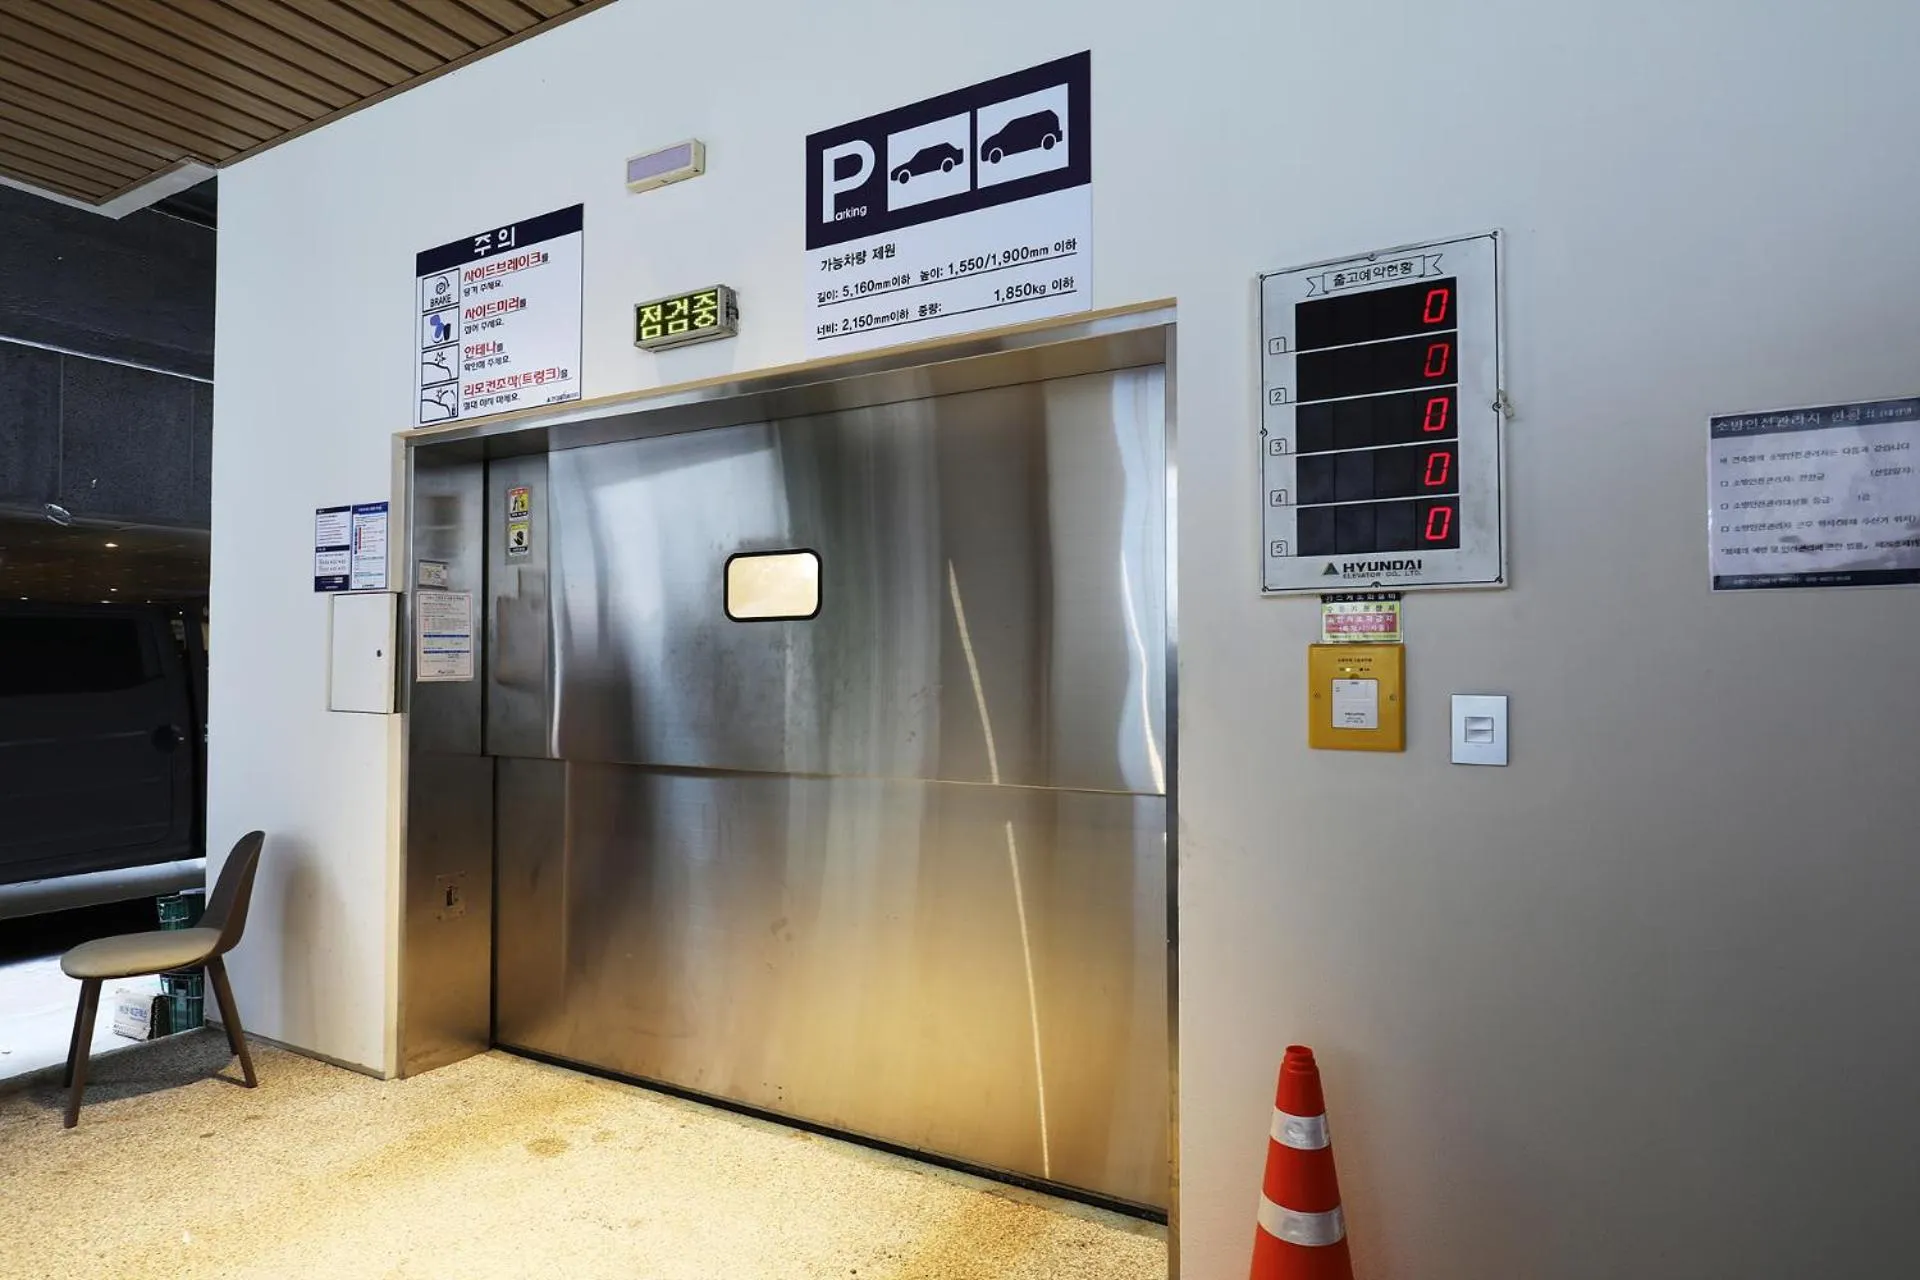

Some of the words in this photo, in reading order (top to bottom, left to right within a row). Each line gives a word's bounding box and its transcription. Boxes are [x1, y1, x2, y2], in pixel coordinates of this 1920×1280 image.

[464, 251, 549, 282] 사이드브레이크를
[816, 288, 838, 303] 길이:
[842, 274, 911, 299] 5,160mm이하
[919, 266, 943, 283] 높이:
[1053, 238, 1078, 253] 이하
[820, 250, 867, 273] 가능차량
[871, 242, 897, 261] 제원
[1333, 262, 1413, 287] 출고예약현황
[430, 294, 452, 308] BRAKE
[464, 296, 527, 319] 사이드미러를
[816, 321, 838, 336] 너비:
[842, 308, 910, 332] 2,150mm이하
[917, 303, 943, 317] 중량:
[993, 281, 1047, 303] 1,850kg
[1051, 277, 1075, 290] 이하
[1423, 289, 1449, 323] 0
[640, 292, 717, 340] 점검중
[464, 342, 504, 359] 안테나를
[1424, 344, 1449, 377] 0
[1273, 391, 1283, 402] 2
[1424, 398, 1449, 431] 0
[1274, 441, 1283, 452] 3
[1424, 452, 1450, 486] 0
[1275, 494, 1283, 504] 4
[1425, 507, 1452, 540] 0
[1275, 544, 1284, 554] 5
[1343, 559, 1422, 572] HYUNDAI
[1343, 571, 1381, 579] ELEVATOR
